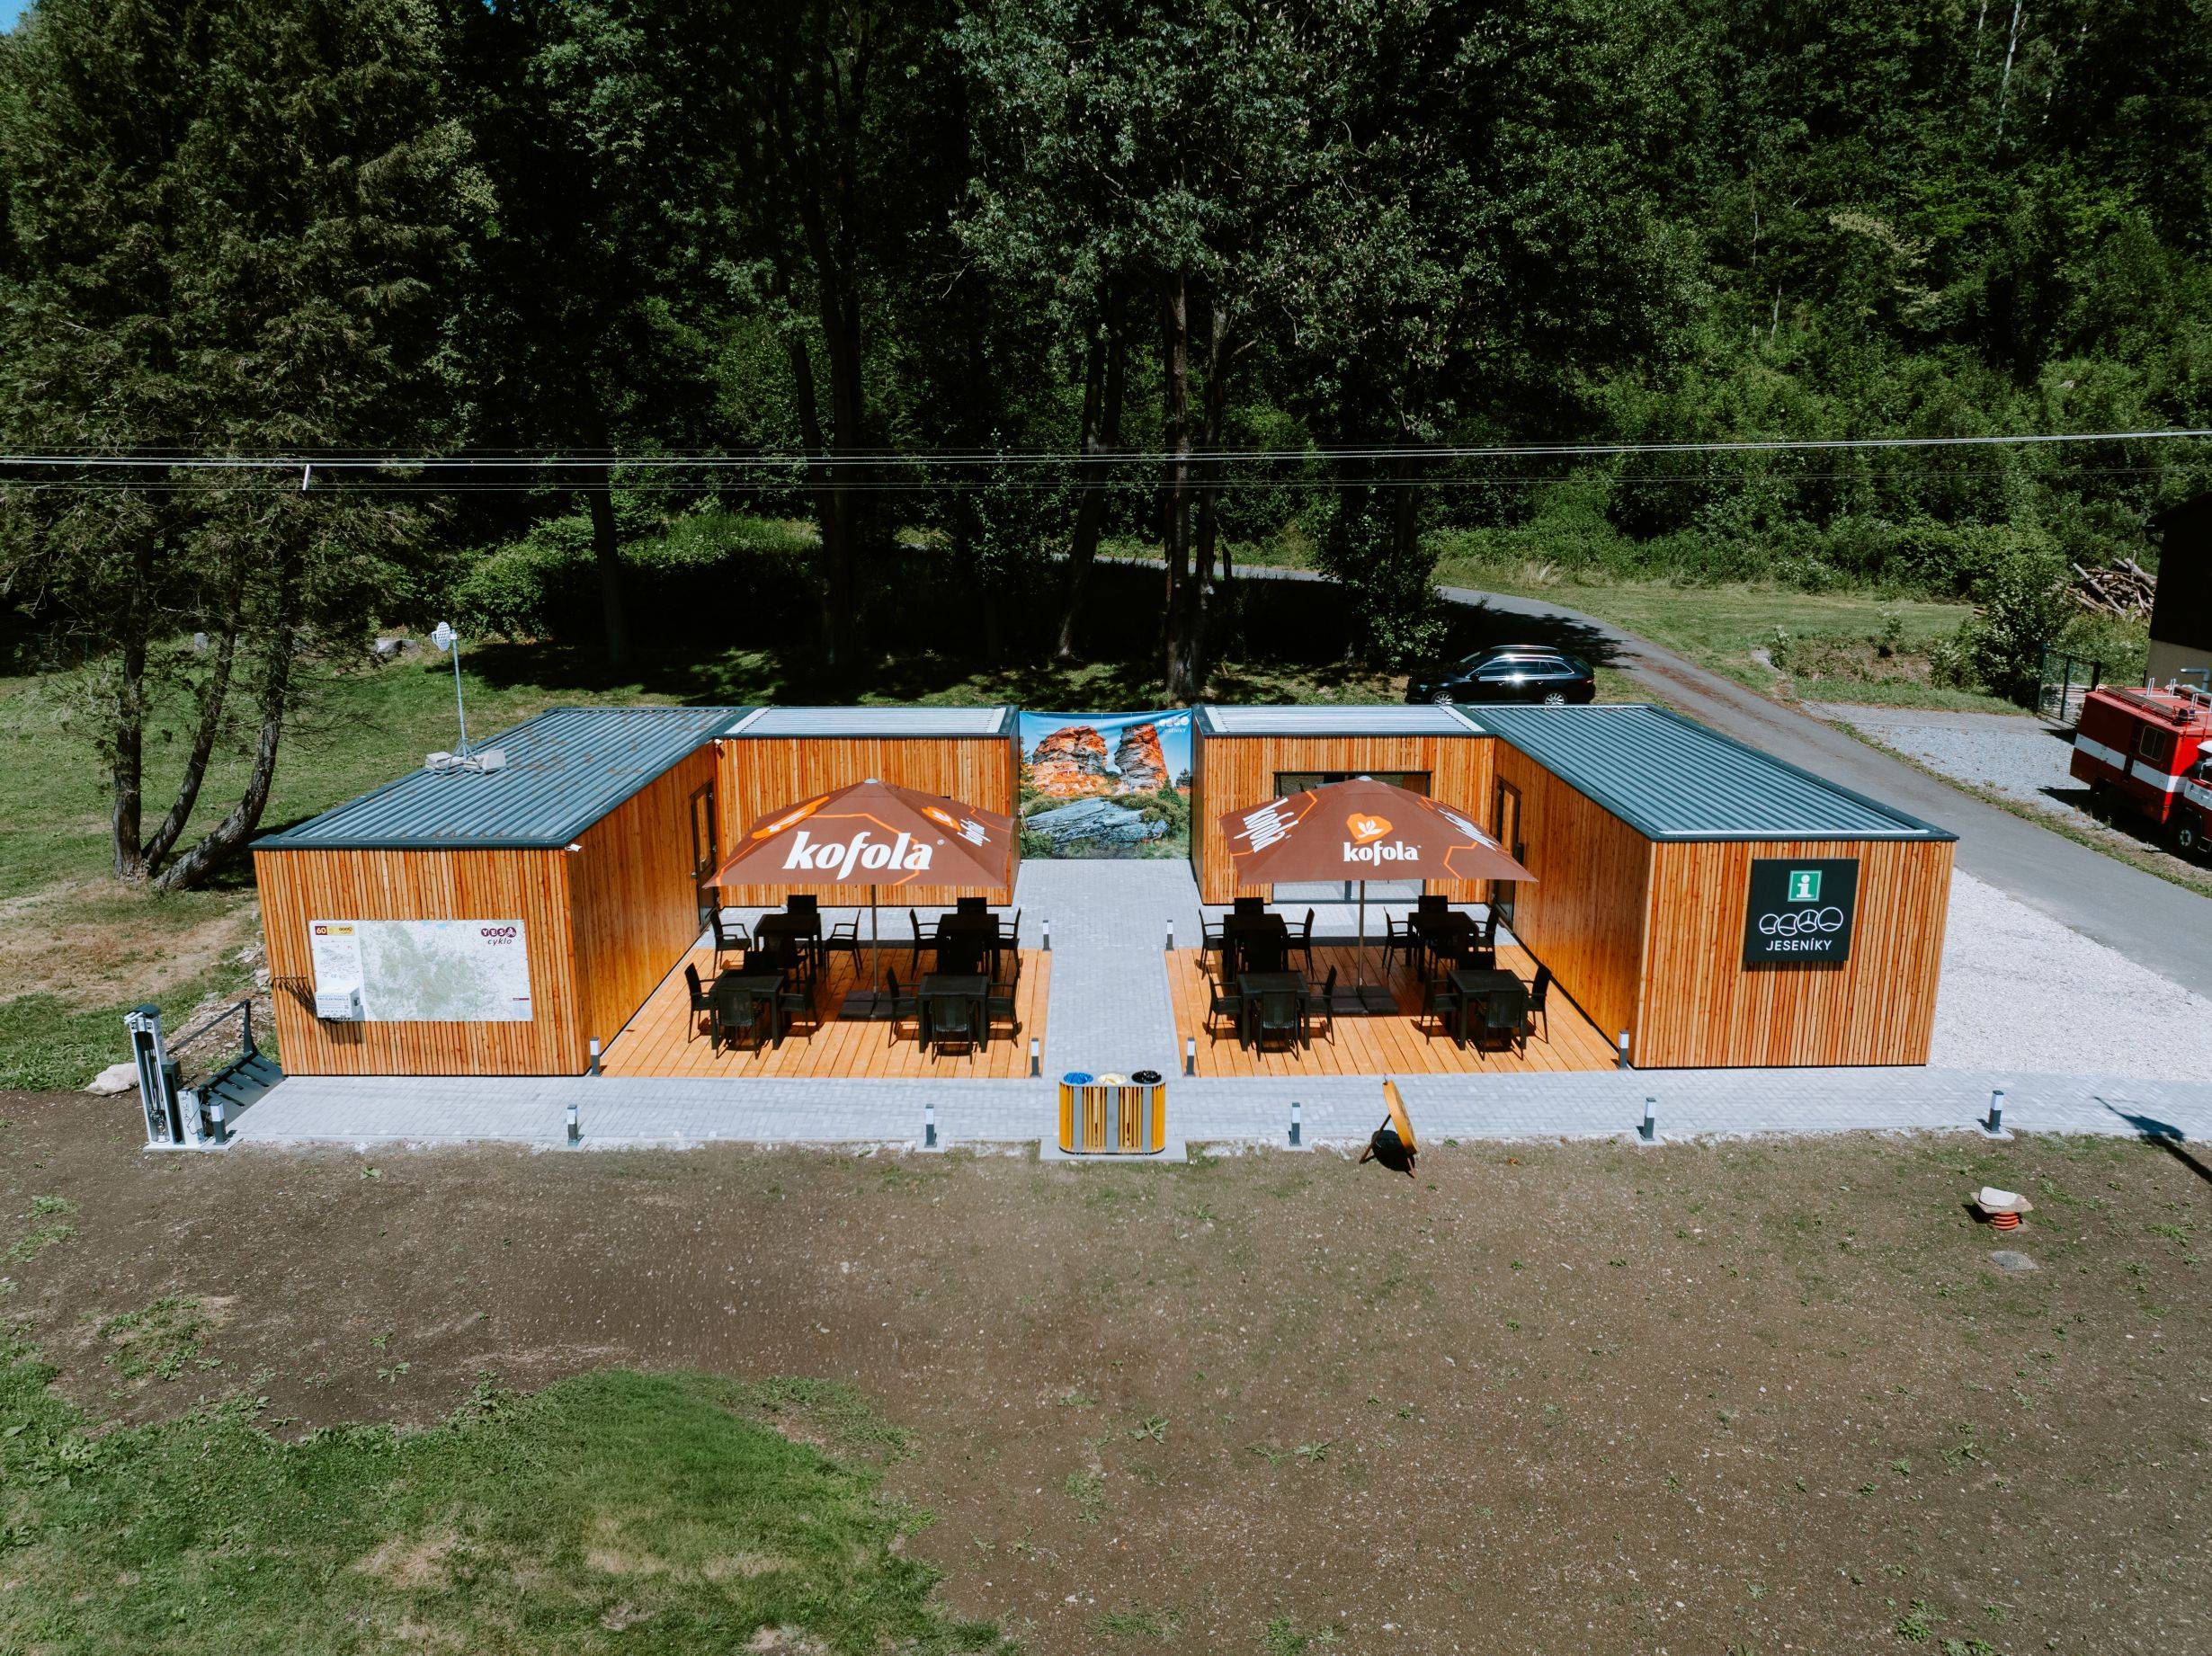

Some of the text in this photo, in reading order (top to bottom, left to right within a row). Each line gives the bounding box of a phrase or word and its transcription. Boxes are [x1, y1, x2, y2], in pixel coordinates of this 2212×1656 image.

[781, 831, 933, 880] kofola
[1343, 841, 1419, 867] kofola
[487, 938, 513, 946] cyklo
[1765, 938, 1833, 951] JESENÍKY
